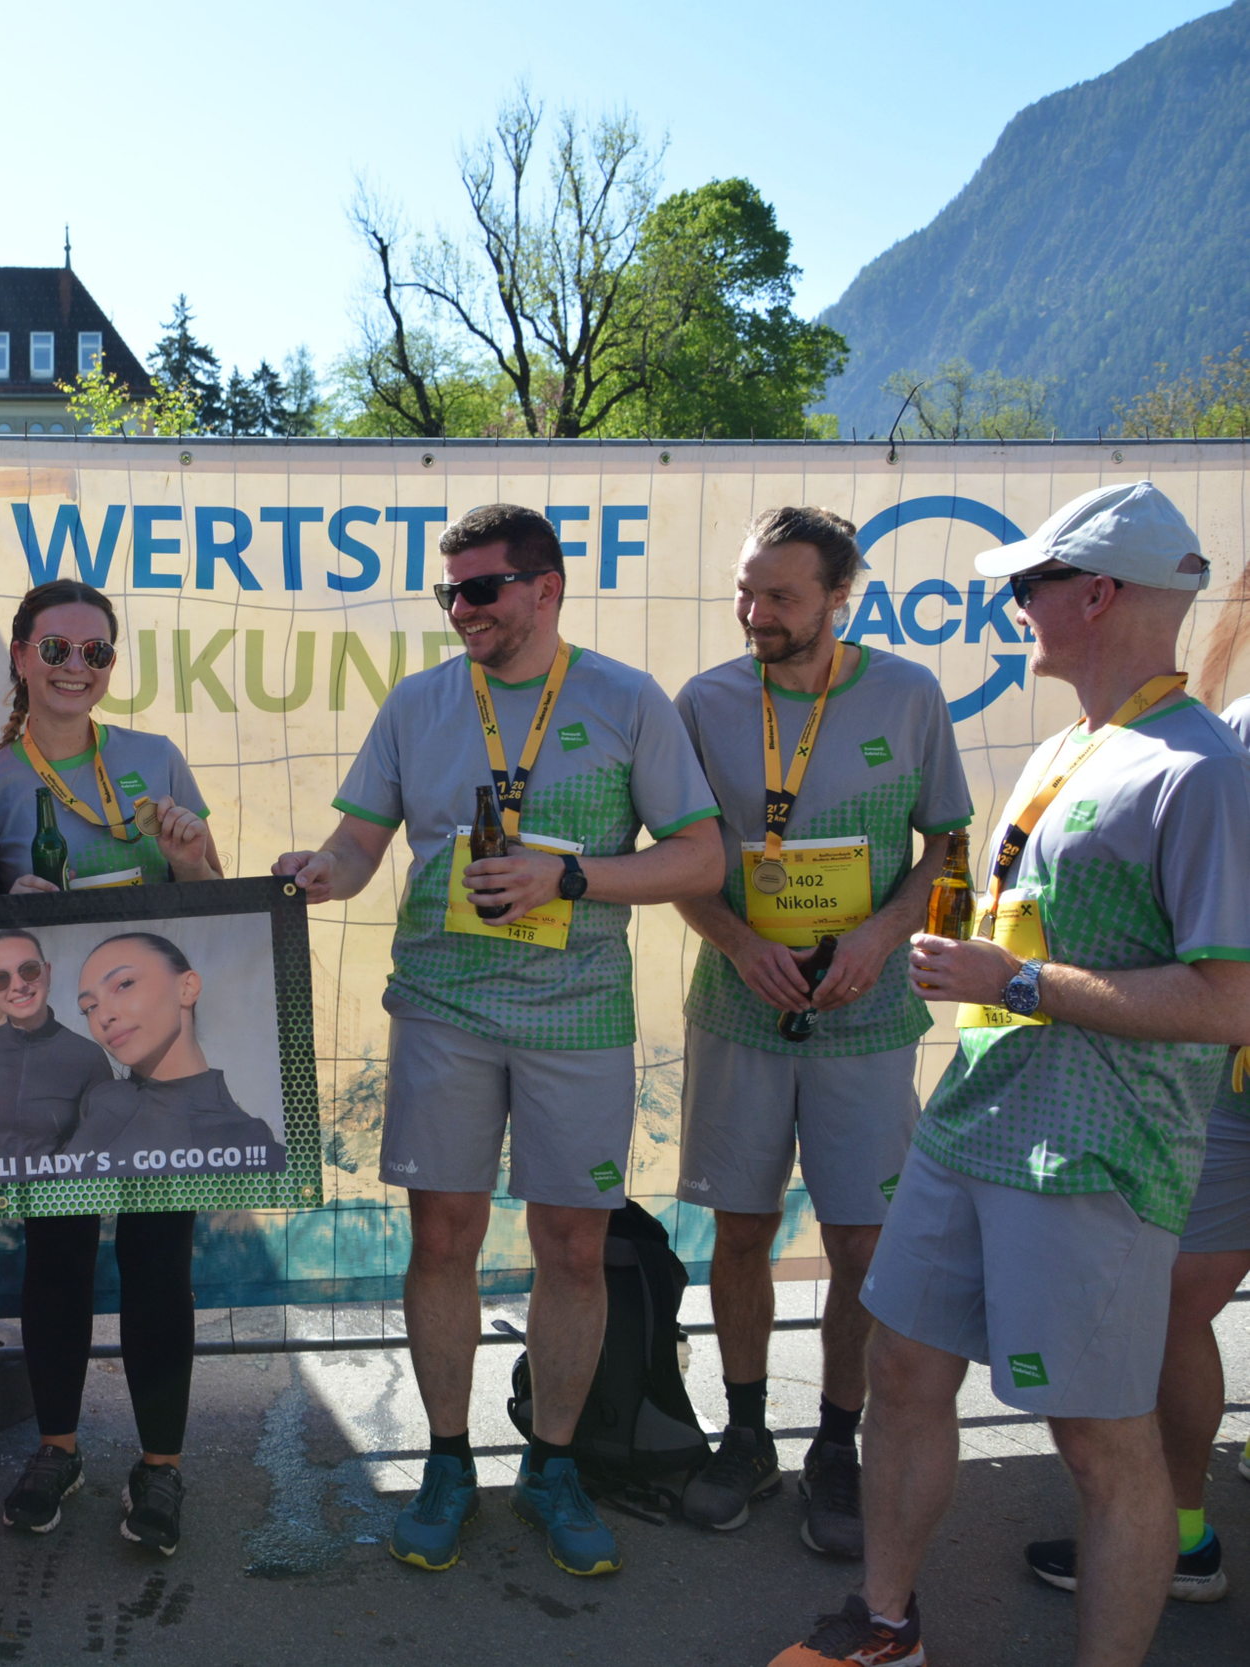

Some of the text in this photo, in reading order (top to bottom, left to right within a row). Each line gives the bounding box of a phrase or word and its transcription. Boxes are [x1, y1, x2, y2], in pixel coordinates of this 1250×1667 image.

[11, 502, 648, 592] WERTSTFF
[497, 781, 506, 793] 7
[511, 781, 525, 790] 20
[509, 790, 521, 799] 26
[779, 803, 789, 815] 7
[774, 814, 787, 823] km
[1003, 842, 1020, 856] 20
[788, 874, 824, 887] 1402
[776, 895, 838, 910] Nikolas
[508, 928, 535, 941] 1418
[985, 1012, 1012, 1024] 1415
[133, 1150, 167, 1170] GO
[170, 1149, 204, 1168] GO
[207, 1147, 241, 1167] GO
[245, 1146, 267, 1166] !!!
